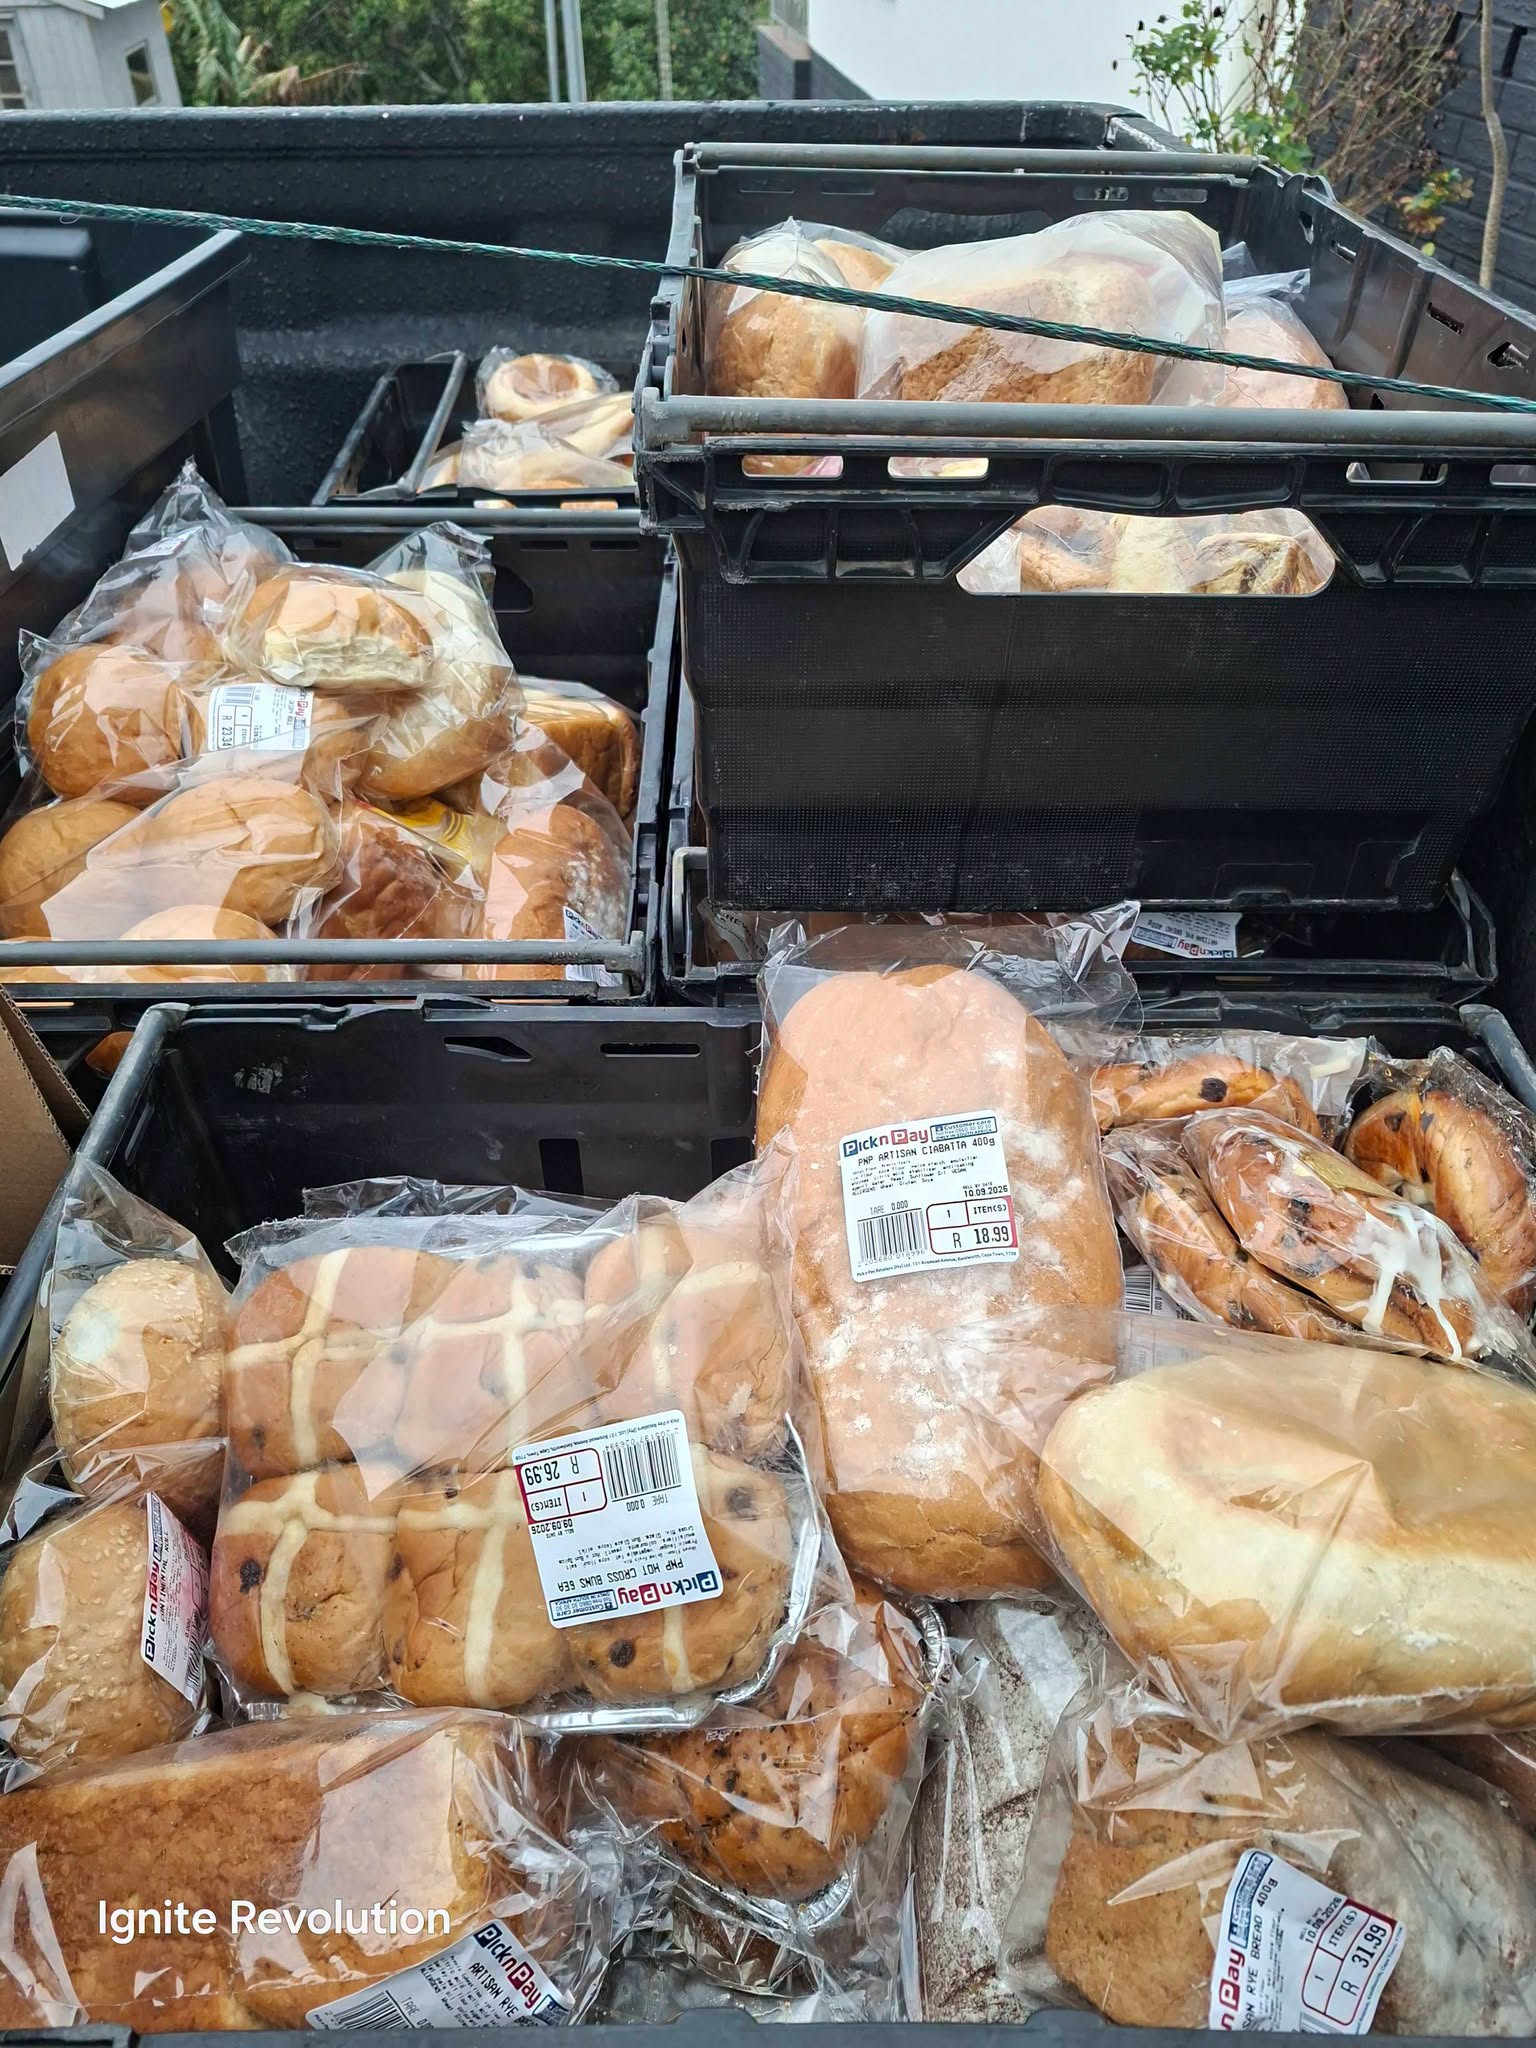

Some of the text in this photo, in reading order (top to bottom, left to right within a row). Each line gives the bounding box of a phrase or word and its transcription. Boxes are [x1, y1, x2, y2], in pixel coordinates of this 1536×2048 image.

[858, 1134, 995, 1165] PNP ARTISAN CIABATTA 400g
[964, 1184, 1008, 1198] 10.09.2026
[947, 1204, 1006, 1218] 1 ITEM(S)
[953, 1224, 1009, 1248] R 18.99
[523, 1456, 579, 1485] R 26.99
[529, 1492, 586, 1512] 1 ITEM(S)
[530, 1517, 573, 1535] 09.09.2026
[607, 1568, 637, 1582] CROSS
[643, 1563, 660, 1575] HOT
[666, 1558, 683, 1570] PNP
[579, 1575, 602, 1588] BUNS
[1257, 1877, 1278, 1907] 400g
[1250, 1915, 1263, 1960] BREAD
[1329, 1910, 1358, 1947] ITEM(S)
[1341, 1924, 1387, 1996] R 31.99
[468, 1962, 519, 2017] ARTISAN RYE
[1246, 1966, 1258, 1995] RYE
[402, 1997, 420, 2016] TARE
